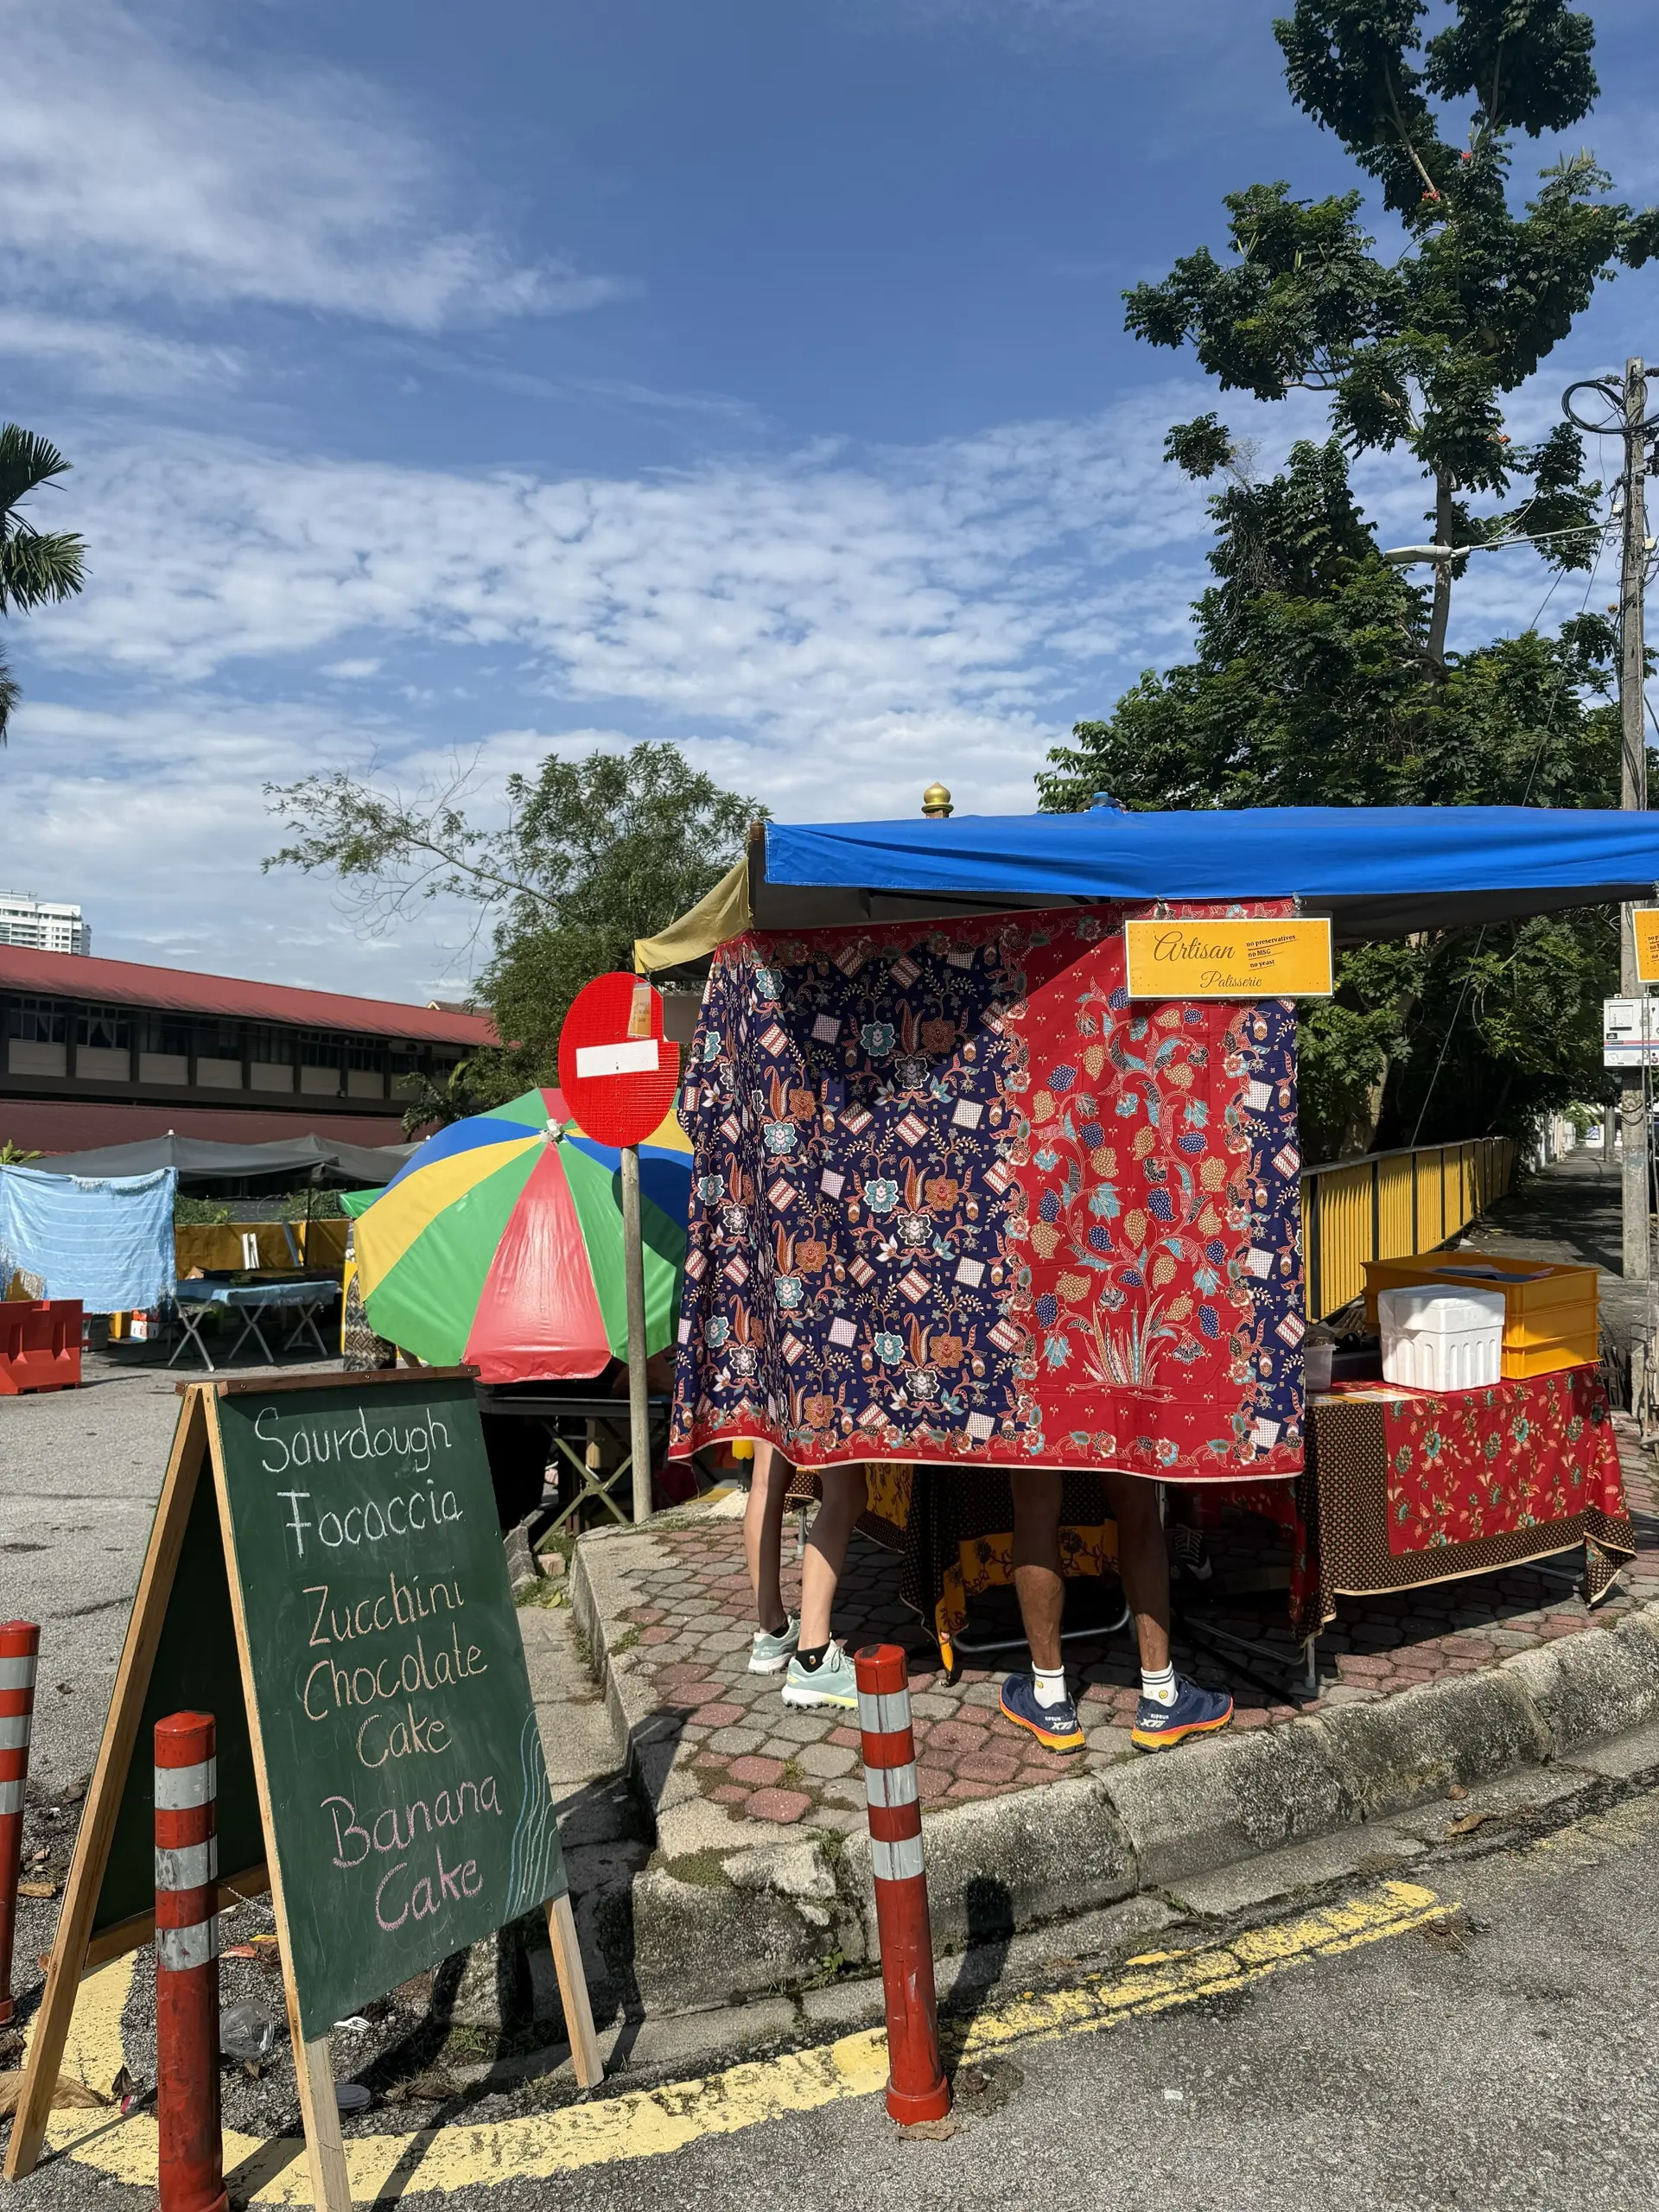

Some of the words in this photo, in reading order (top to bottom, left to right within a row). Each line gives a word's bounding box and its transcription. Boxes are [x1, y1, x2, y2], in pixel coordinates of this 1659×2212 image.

[1154, 931, 1236, 961] Artisan
[1255, 934, 1296, 947] preservatives
[1256, 948, 1271, 957] MSG
[1200, 970, 1262, 988] Patisserie
[277, 1478, 463, 1558] Focaccia
[302, 1567, 465, 1647] Zucchini
[304, 1622, 488, 1721] Chocolate
[357, 1703, 453, 1768] Cake
[321, 1776, 503, 1868] Banana
[375, 1843, 484, 1931] Cake
